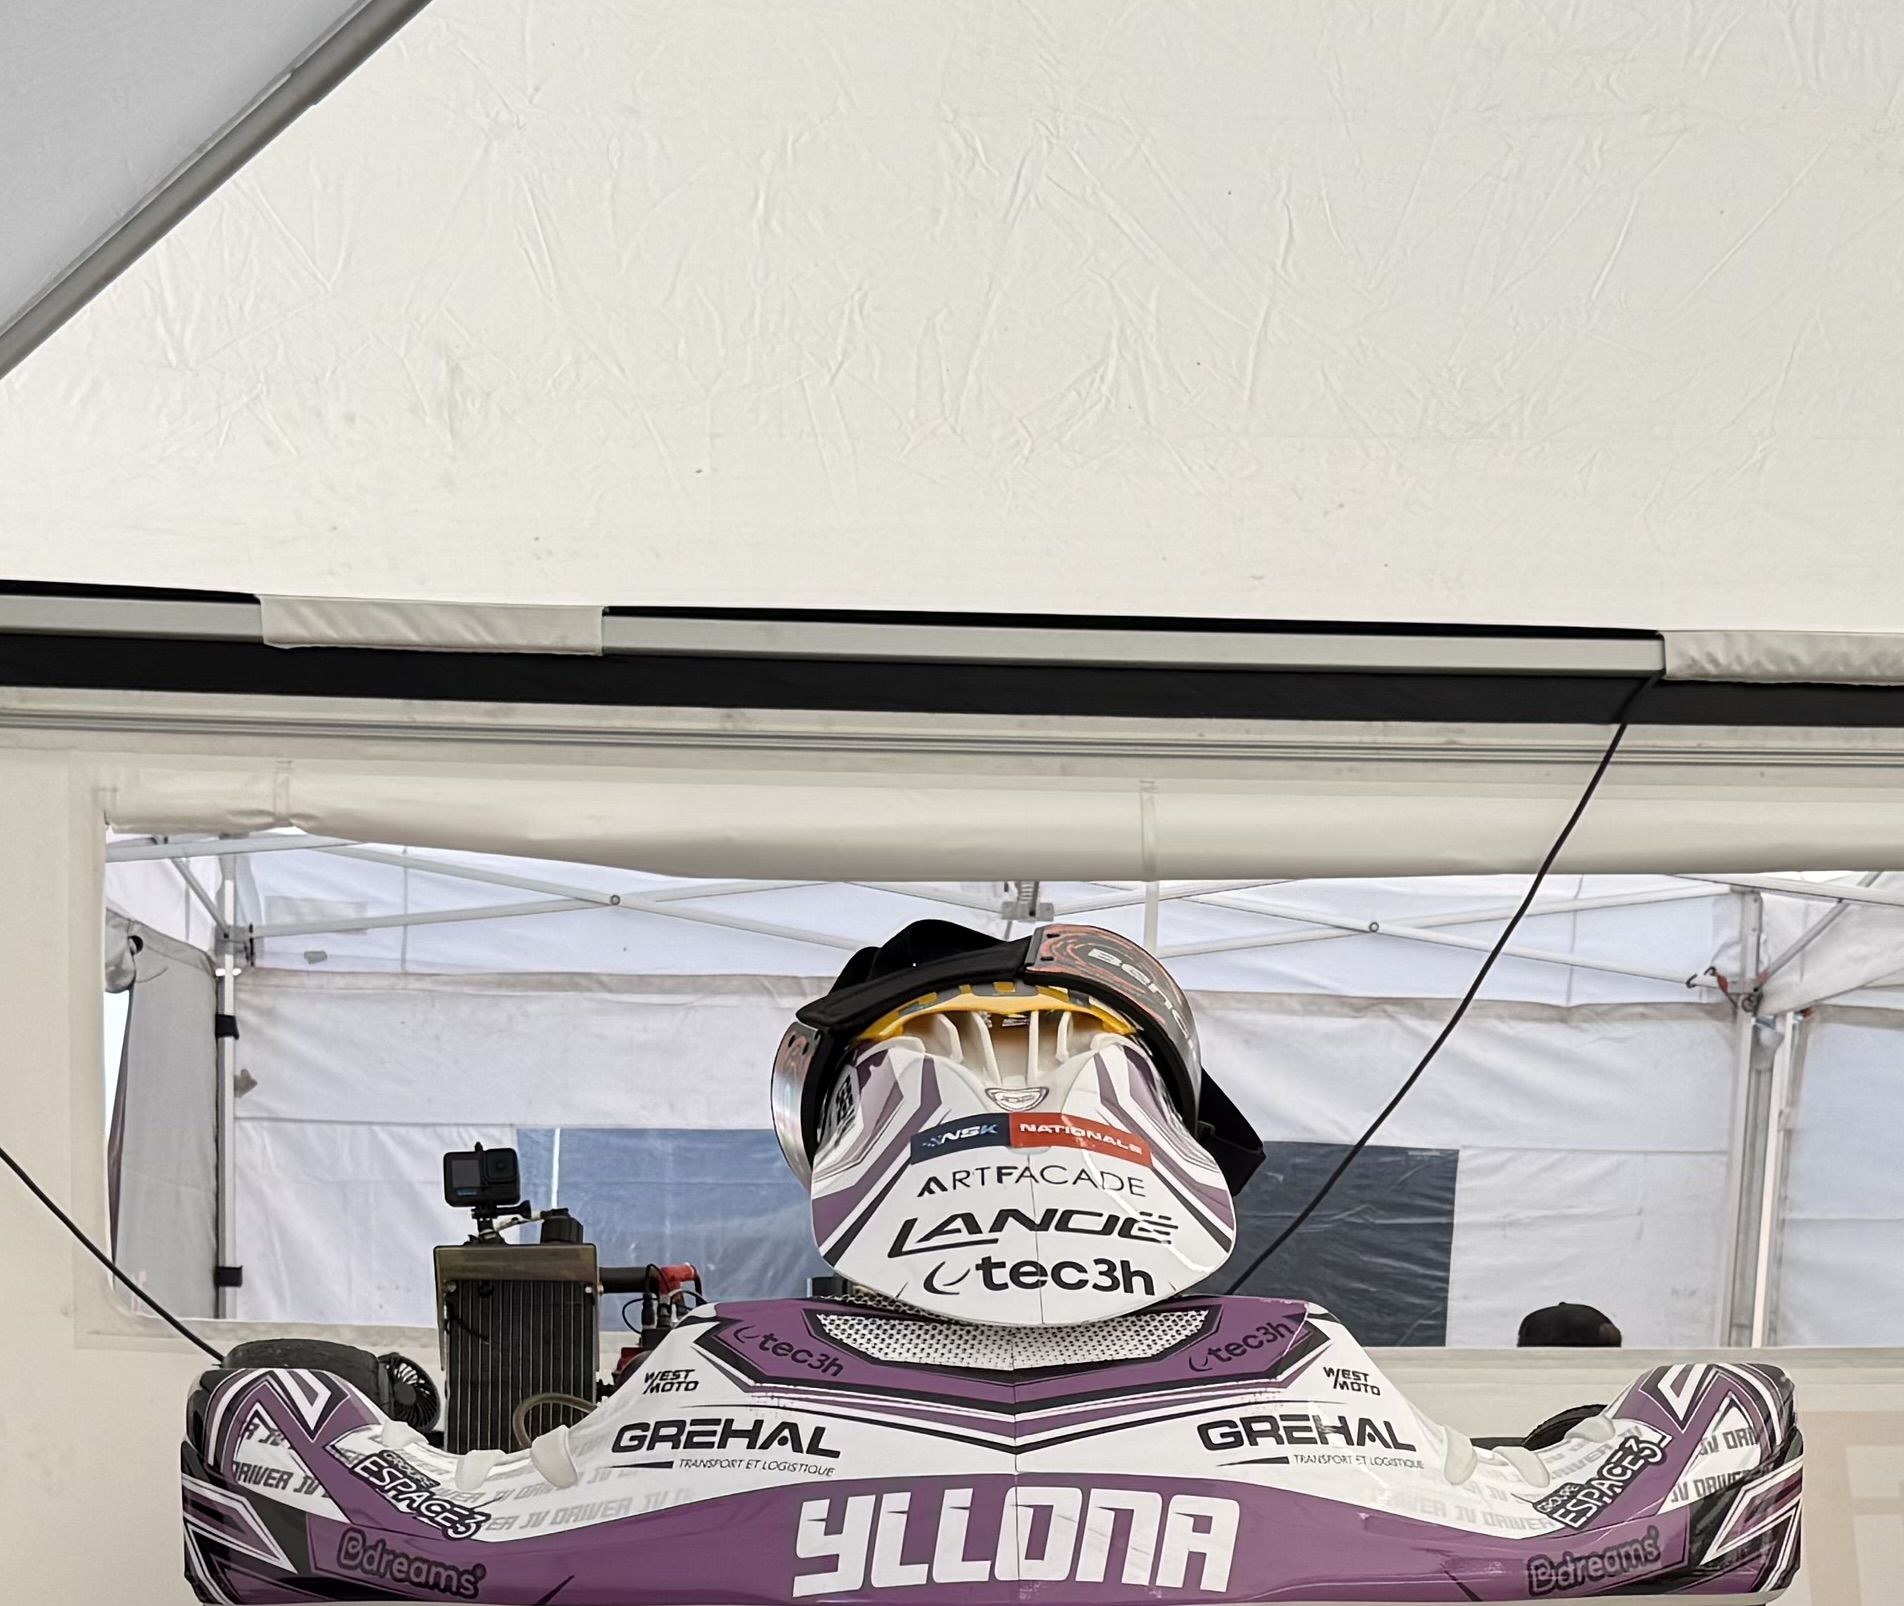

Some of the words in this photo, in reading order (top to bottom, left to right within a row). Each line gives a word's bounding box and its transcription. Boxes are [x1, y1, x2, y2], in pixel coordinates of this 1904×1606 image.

[1019, 1122, 1143, 1155] NATIONALS
[917, 1165, 1146, 1198] ARTFACADE
[976, 1255, 1155, 1296] tec3h
[761, 1332, 845, 1378] tec3h
[1209, 1321, 1293, 1364] tec3h
[643, 1380, 700, 1394] MOTO
[644, 1369, 696, 1383] WEST
[1323, 1366, 1371, 1384] WEST
[1333, 1379, 1381, 1397] MOTO
[611, 1418, 842, 1460] GREHAL
[1197, 1414, 1417, 1452] GREHAL
[678, 1458, 744, 1471] TRANSPORT
[745, 1462, 760, 1471] ET
[761, 1462, 835, 1477] LOGISTIQUE
[1293, 1454, 1353, 1466] TRANSPORT
[1355, 1455, 1367, 1466] ET
[1368, 1456, 1425, 1470] LOGISTIQUE
[792, 1486, 1240, 1598] YLLONA
